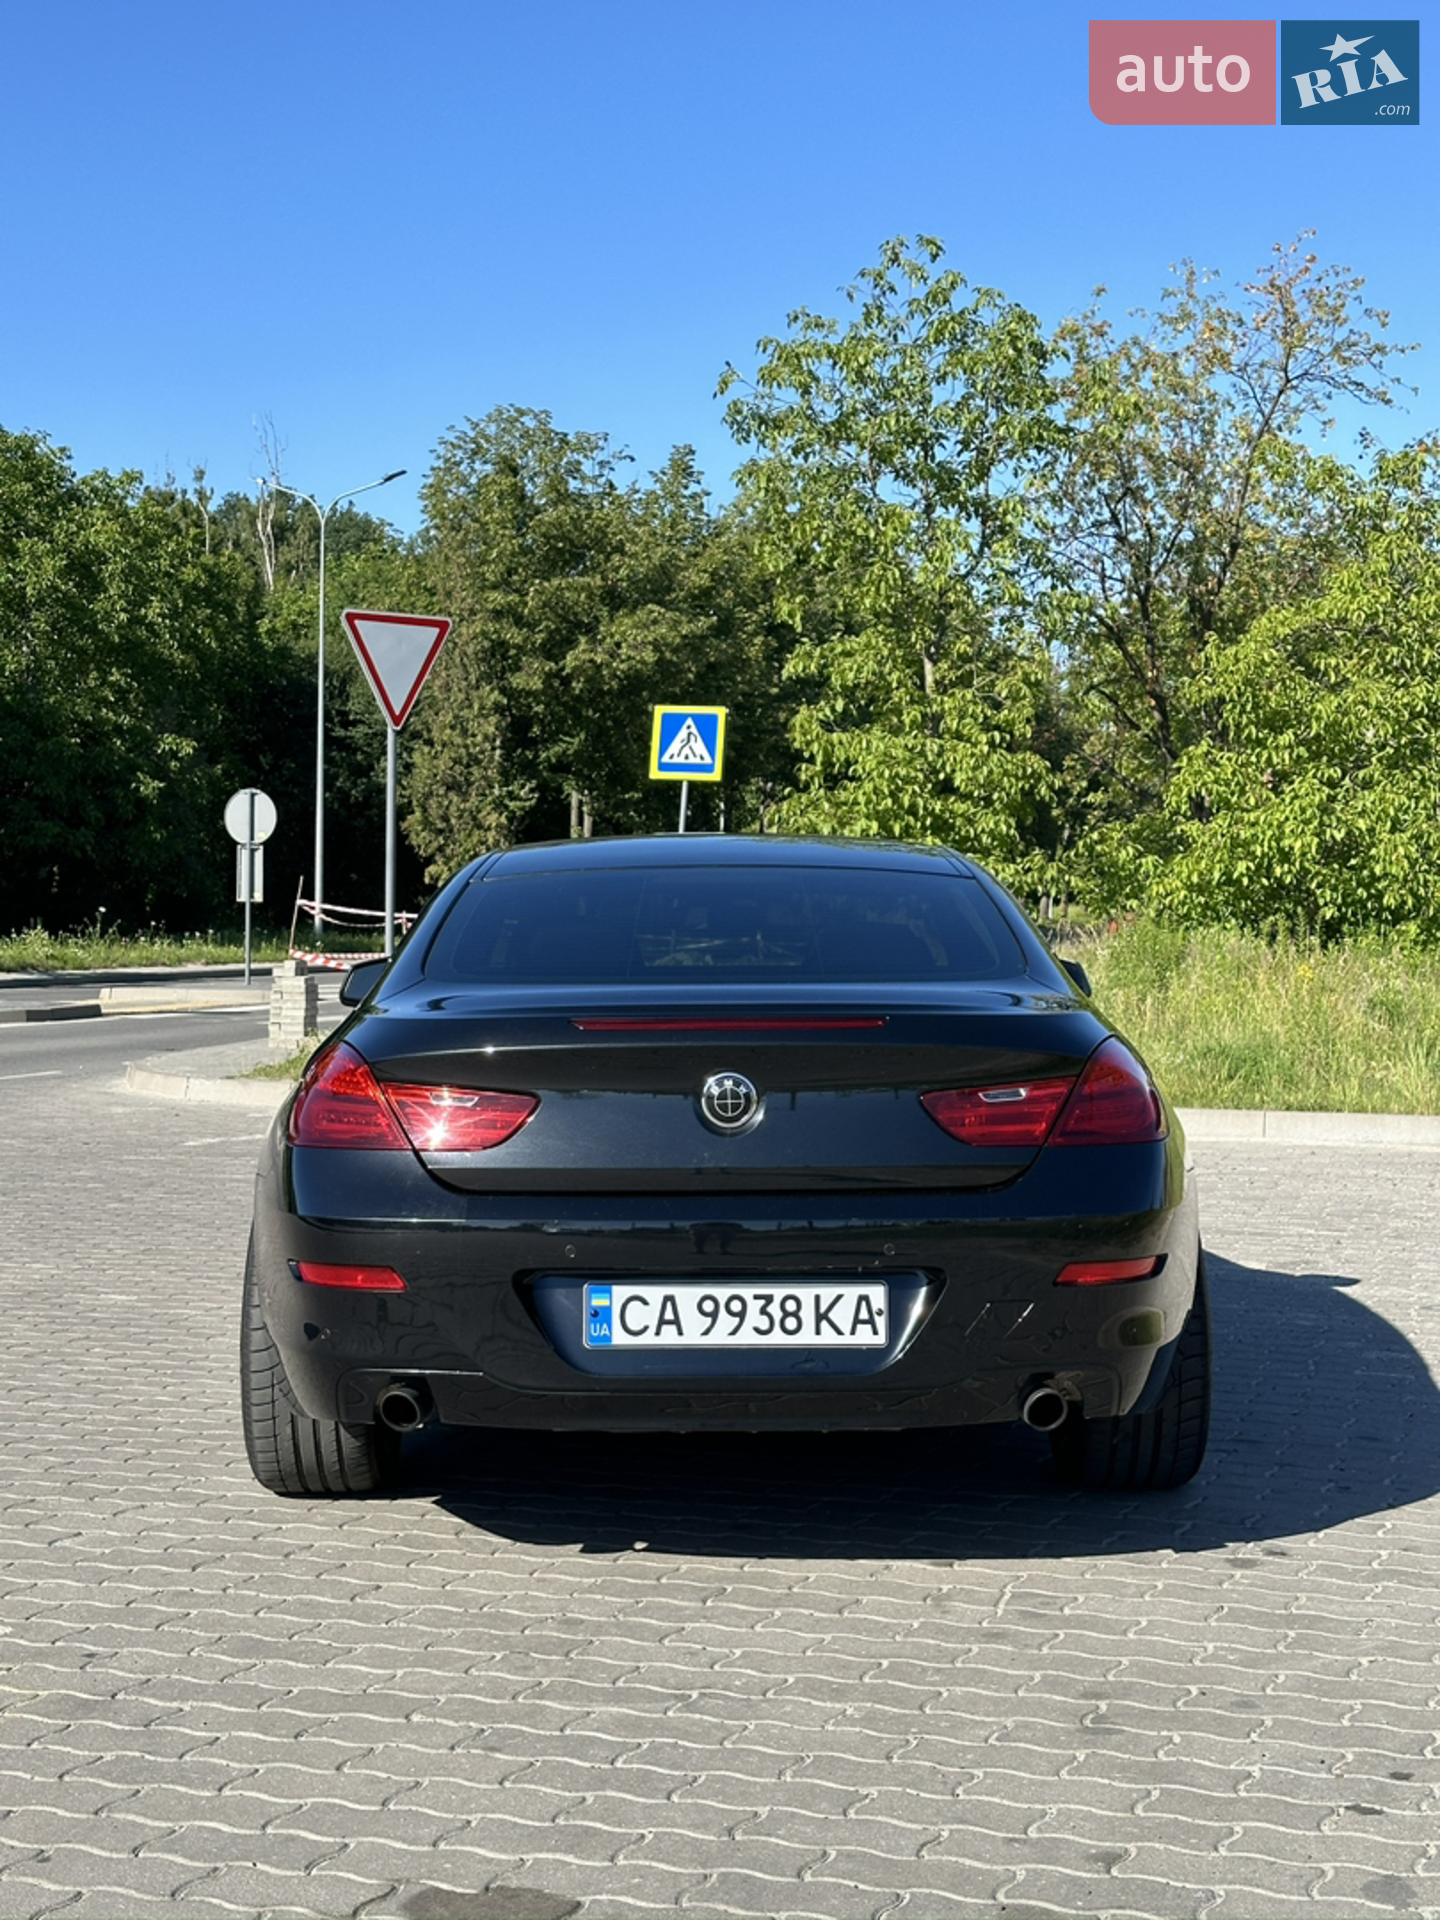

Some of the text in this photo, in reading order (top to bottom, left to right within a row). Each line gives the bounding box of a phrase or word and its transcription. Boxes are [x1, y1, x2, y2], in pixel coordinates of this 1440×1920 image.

[590, 1322, 611, 1337] UA
[618, 1293, 879, 1337] CA 9938 KA
